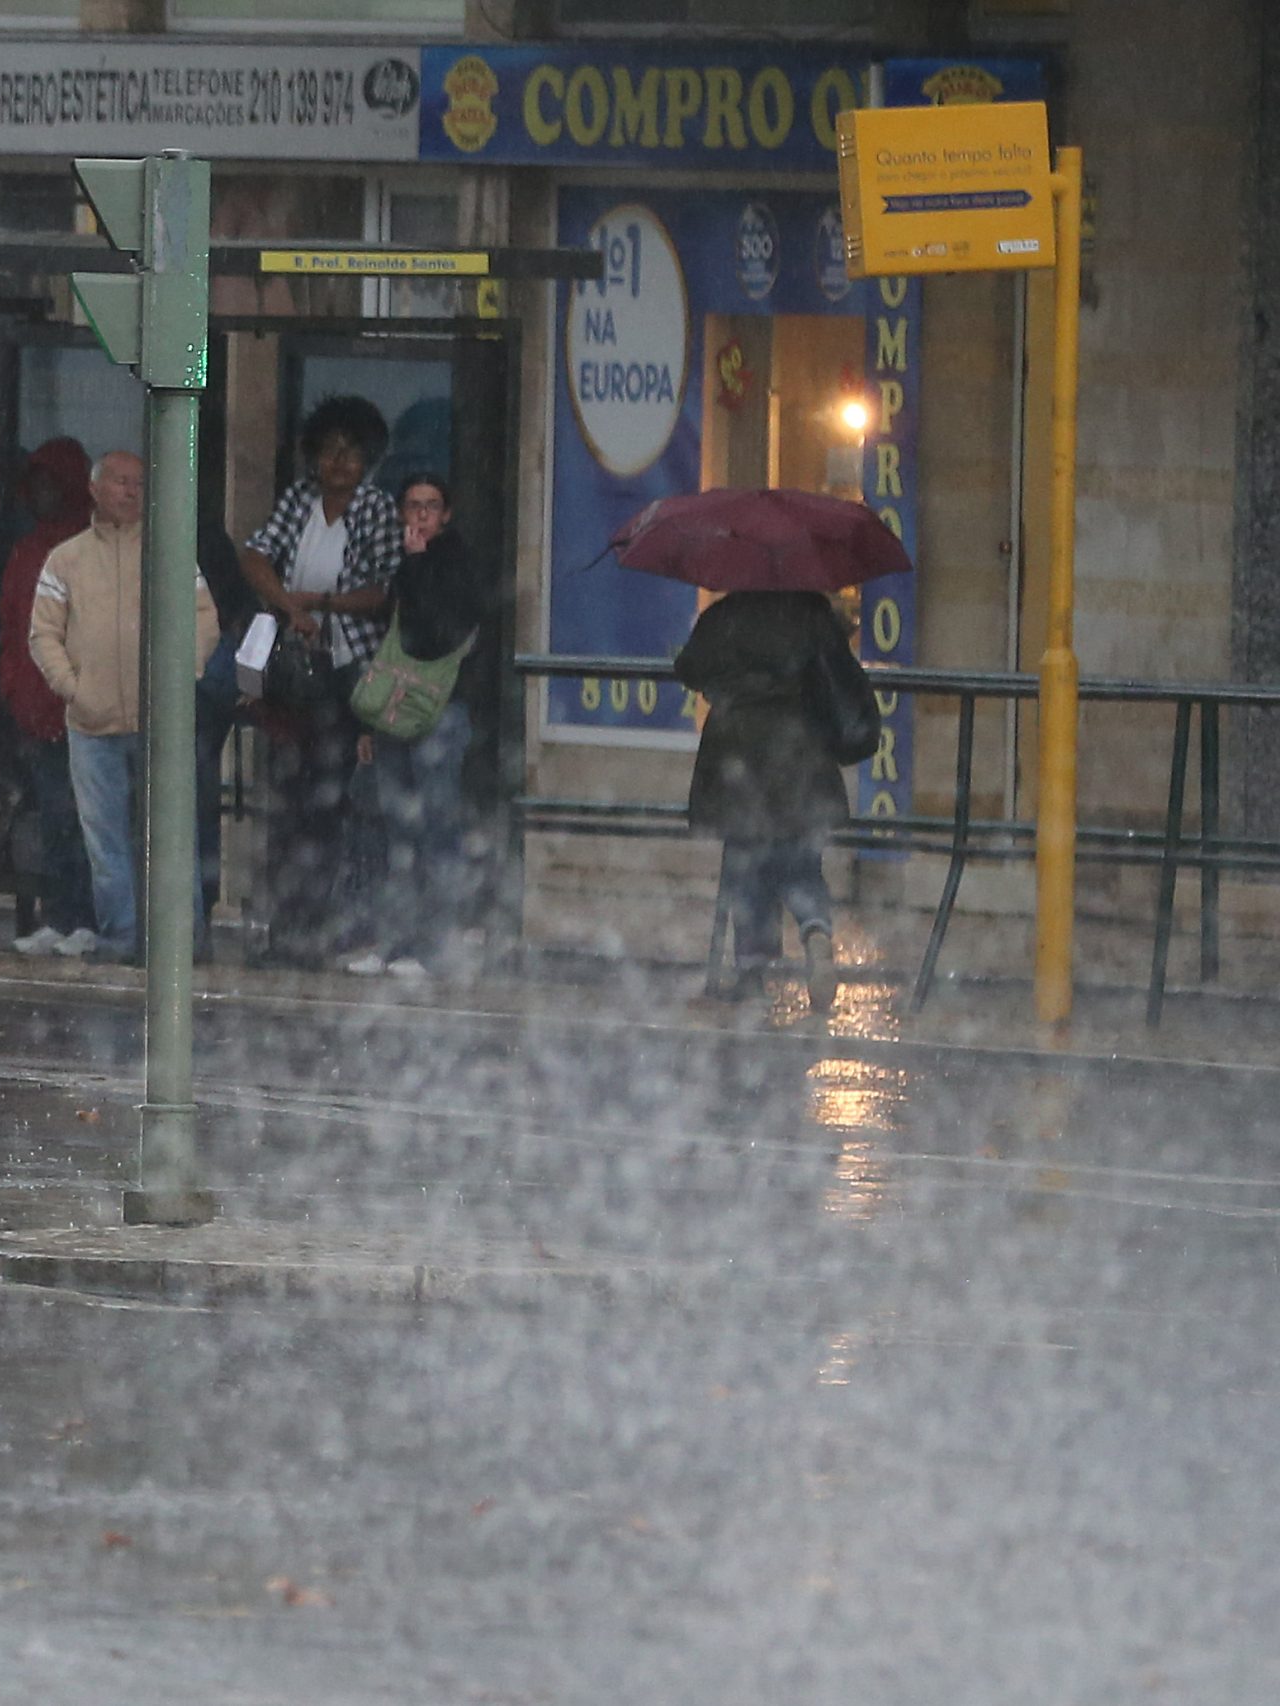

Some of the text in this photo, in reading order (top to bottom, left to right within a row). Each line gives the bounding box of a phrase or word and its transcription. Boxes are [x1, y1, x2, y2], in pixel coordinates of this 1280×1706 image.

[61, 56, 150, 125] ESTÉTICA
[153, 67, 245, 97] TELEFONE
[247, 67, 282, 126] 210
[287, 69, 319, 126] 139
[322, 69, 355, 127] 974
[523, 63, 794, 149] COMPRO
[876, 143, 1033, 167] Quanto tempo falta
[584, 307, 617, 346] NA
[579, 360, 674, 403] EUROPA
